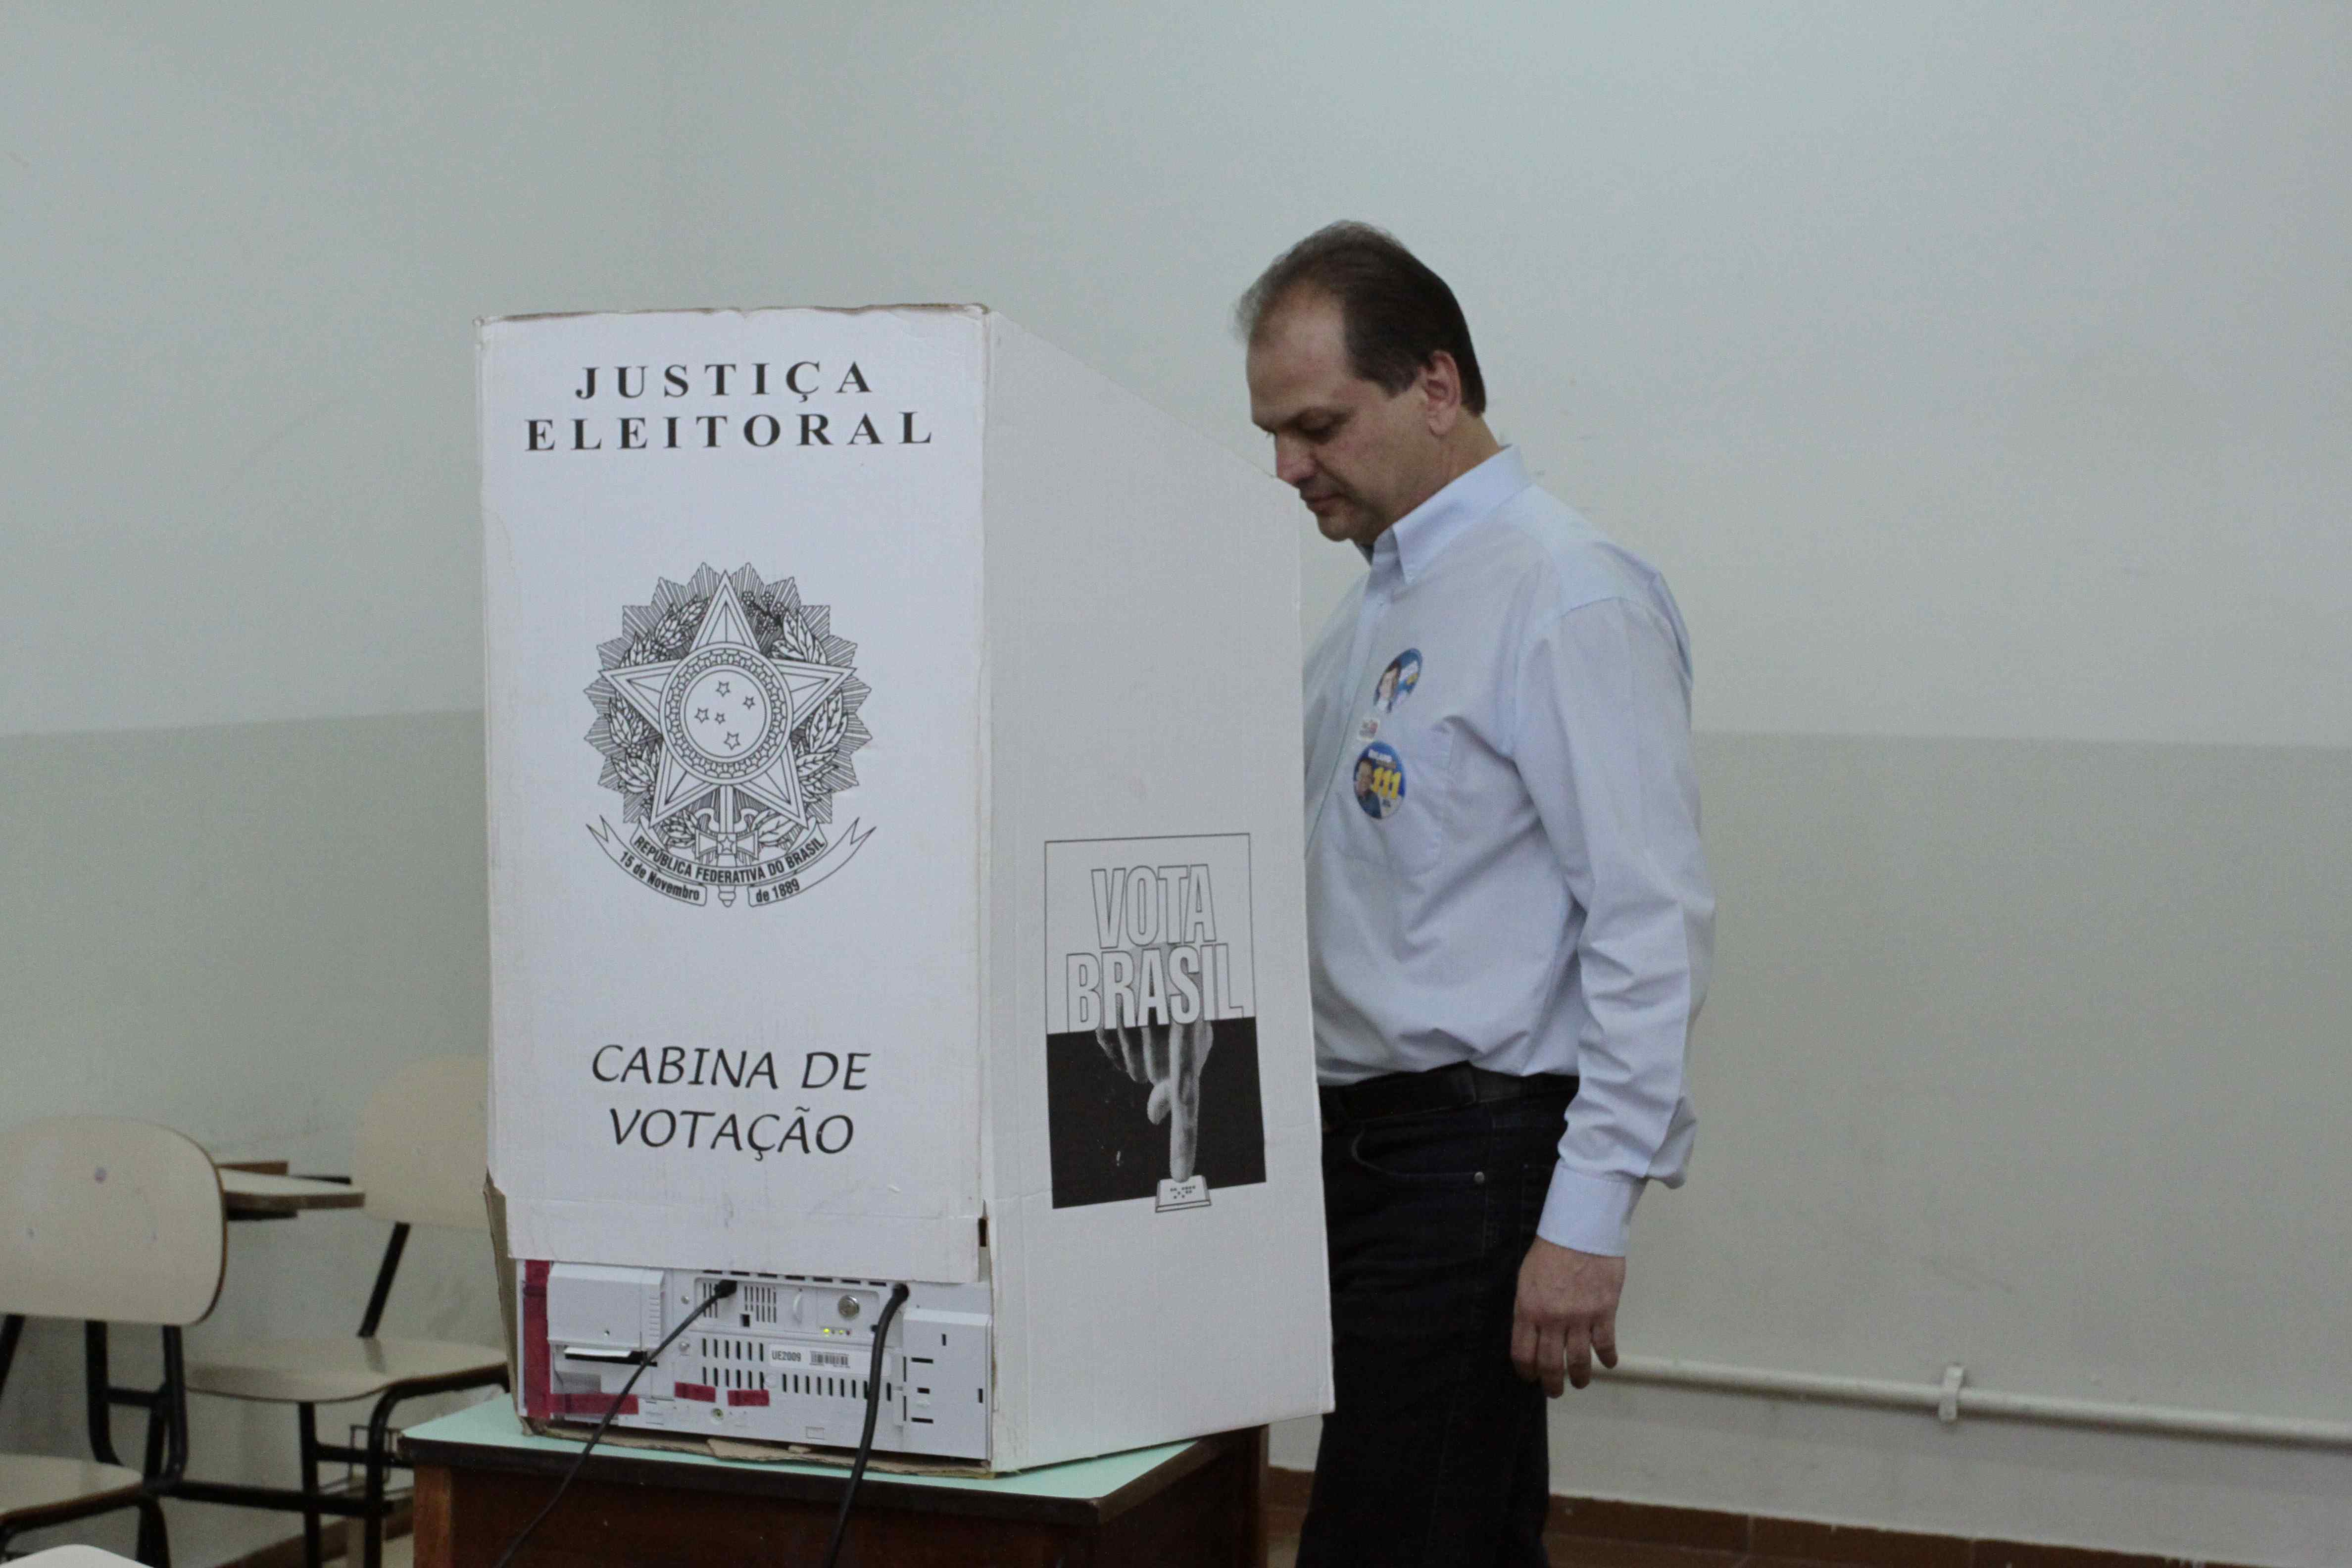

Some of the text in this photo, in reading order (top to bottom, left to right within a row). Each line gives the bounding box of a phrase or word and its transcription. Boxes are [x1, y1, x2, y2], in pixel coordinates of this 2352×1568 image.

[575, 361, 872, 402] JUSTIÇA
[525, 411, 931, 451] ELEITORAL
[620, 851, 800, 903] 15 de Novembro de 1889
[695, 866, 766, 884] FEDERATIVA
[768, 860, 784, 876] DO
[785, 837, 825, 868] BRASIL
[1090, 864, 1217, 949] VOTA
[1067, 942, 1244, 1033] BRASIL
[592, 1044, 871, 1090] CABINA DE
[609, 1106, 854, 1162] VOTAÇÃO
[771, 1350, 801, 1362] UE2009
